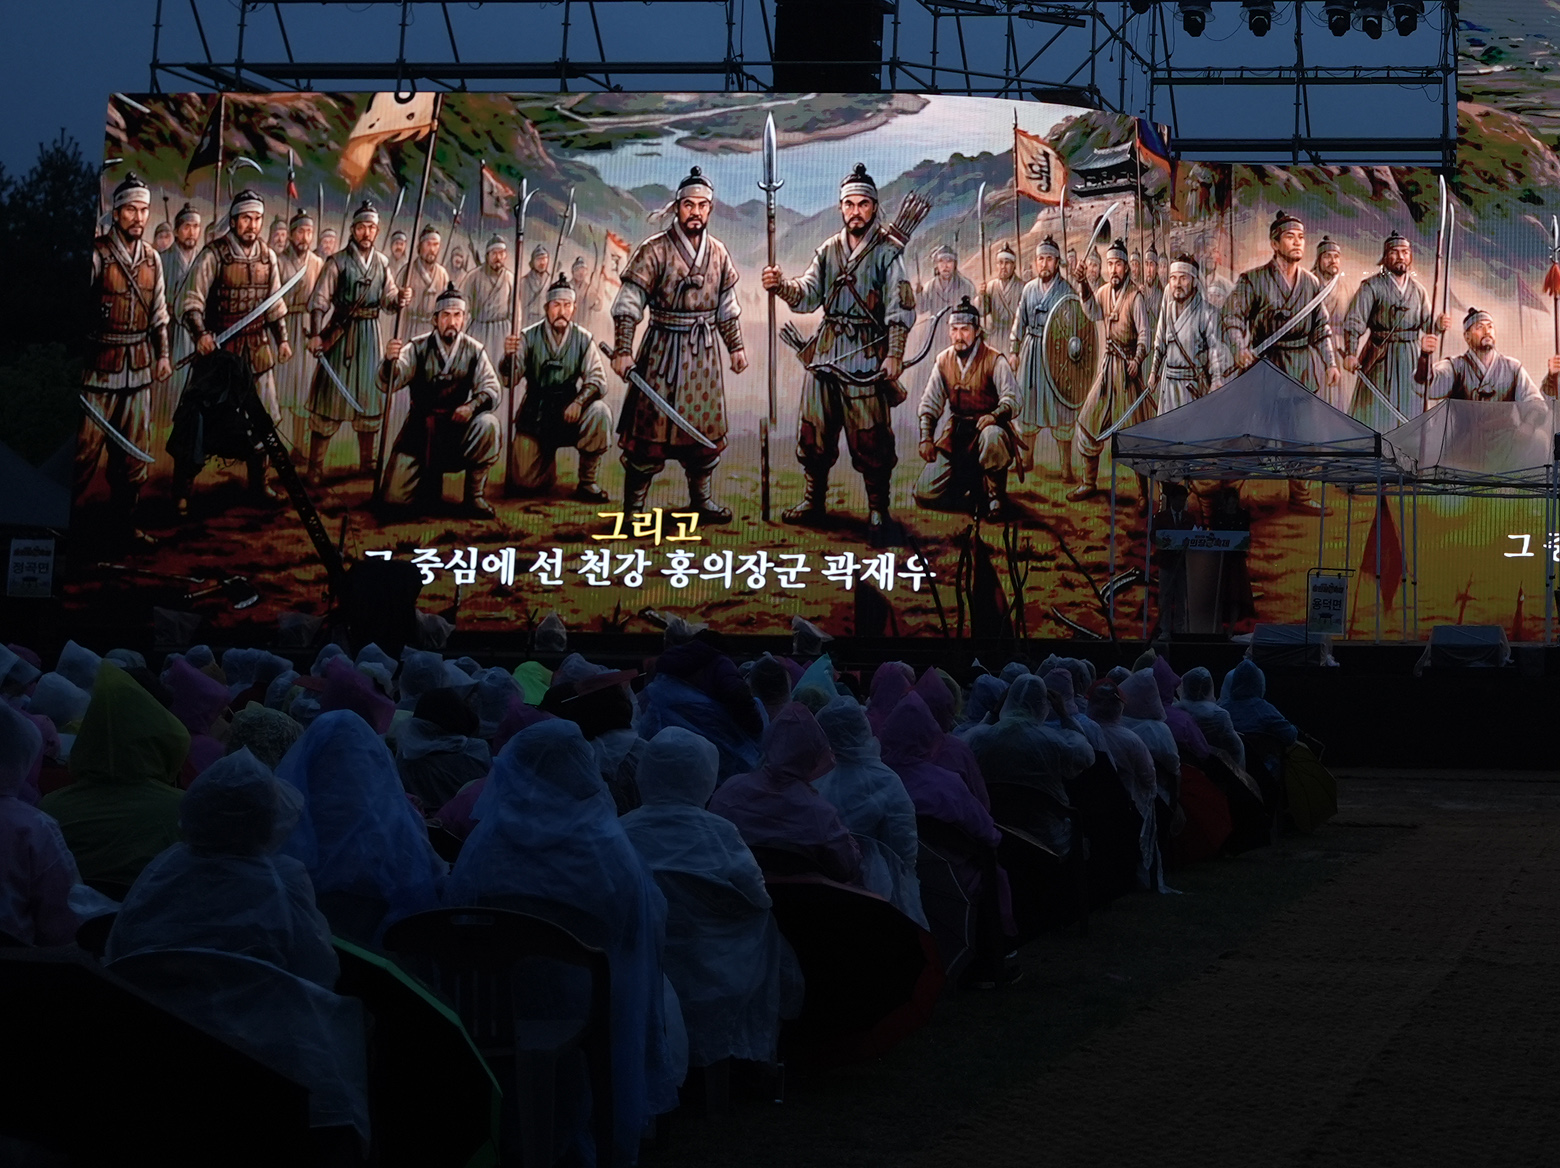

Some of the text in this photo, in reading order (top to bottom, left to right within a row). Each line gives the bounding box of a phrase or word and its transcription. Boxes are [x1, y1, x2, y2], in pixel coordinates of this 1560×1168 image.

[591, 507, 702, 546] 그리고
[1503, 534, 1535, 558] 그
[410, 546, 937, 592] 중심에 선 천강 홍의장군 곽재우
[1312, 598, 1342, 610] 용덕면
